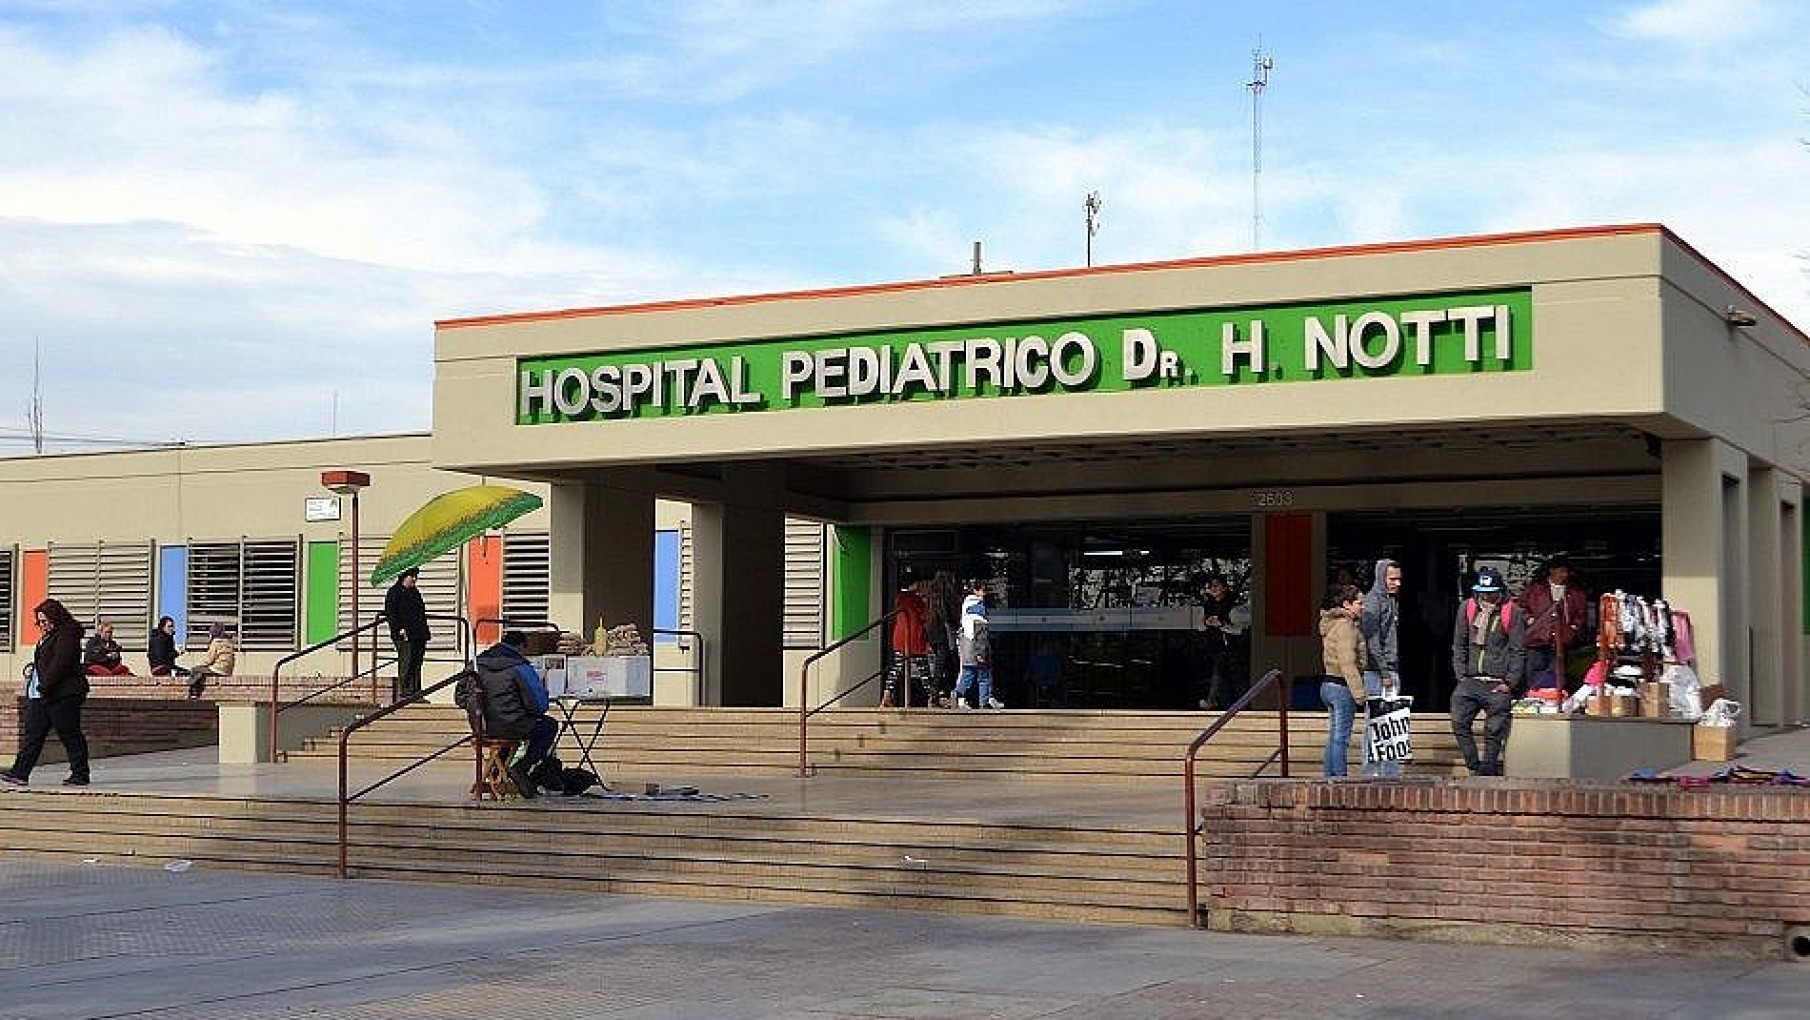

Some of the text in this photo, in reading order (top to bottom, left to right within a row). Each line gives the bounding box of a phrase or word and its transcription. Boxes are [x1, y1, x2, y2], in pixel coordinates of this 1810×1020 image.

[521, 356, 761, 415] HOSPITAL
[782, 332, 1096, 399] PEDIATRICO
[1305, 304, 1511, 371] NOTTI
